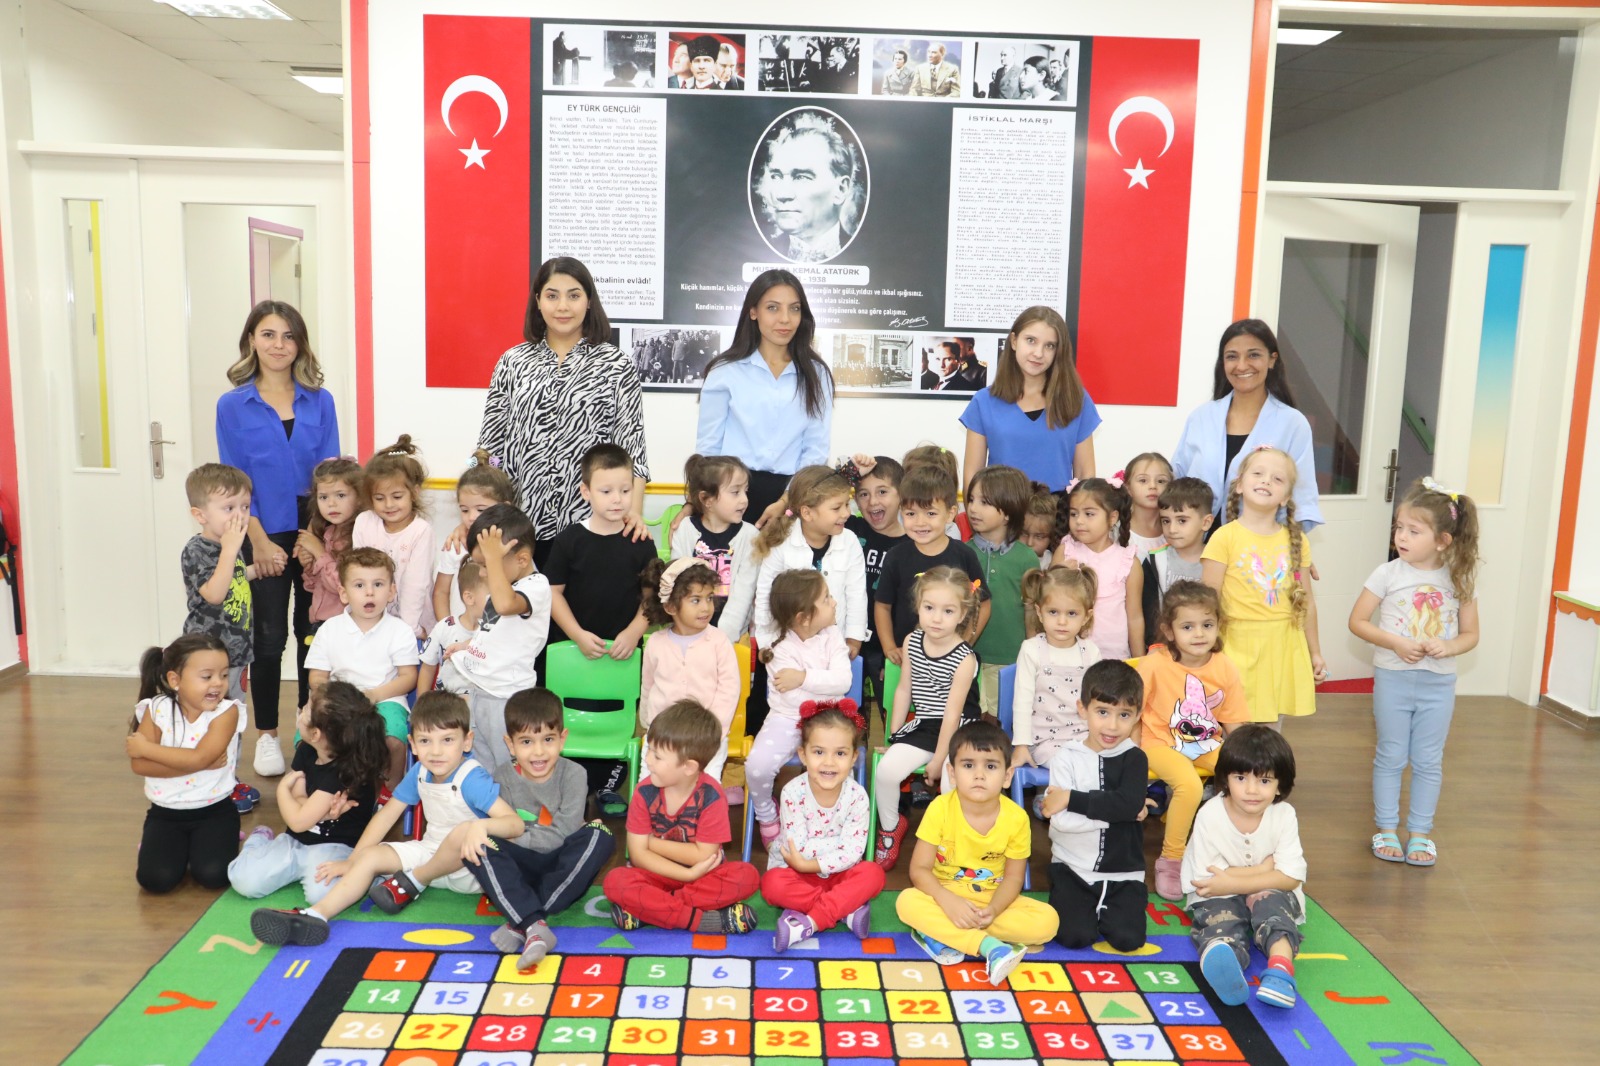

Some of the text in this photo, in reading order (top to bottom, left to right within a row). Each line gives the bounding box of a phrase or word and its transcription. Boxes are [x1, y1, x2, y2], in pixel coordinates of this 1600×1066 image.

[567, 103, 641, 114] EY TÜRK GENÇLİĞİ!
[968, 114, 1053, 125] İSTİKLAL MARŞI
[822, 267, 860, 276] ATATÜRK
[1145, 902, 1193, 926] H
[394, 959, 406, 972] 1
[452, 961, 474, 974] 2
[583, 964, 601, 977] 4
[649, 965, 666, 978] 5
[712, 966, 728, 979] 6
[778, 967, 793, 980] 7
[841, 968, 858, 981] 8
[901, 968, 922, 983] 9
[957, 968, 989, 983] 10
[1021, 970, 1054, 984] 11
[1080, 969, 1120, 985] 12
[1144, 971, 1179, 984] 13
[143, 990, 218, 1015] Y
[368, 989, 1205, 1017] 14 15 16 17 18 19 20 21 22 23 24 25
[341, 1021, 1227, 1052] 26 27 28 29 30 31 32 33 34 35 36 37 38
